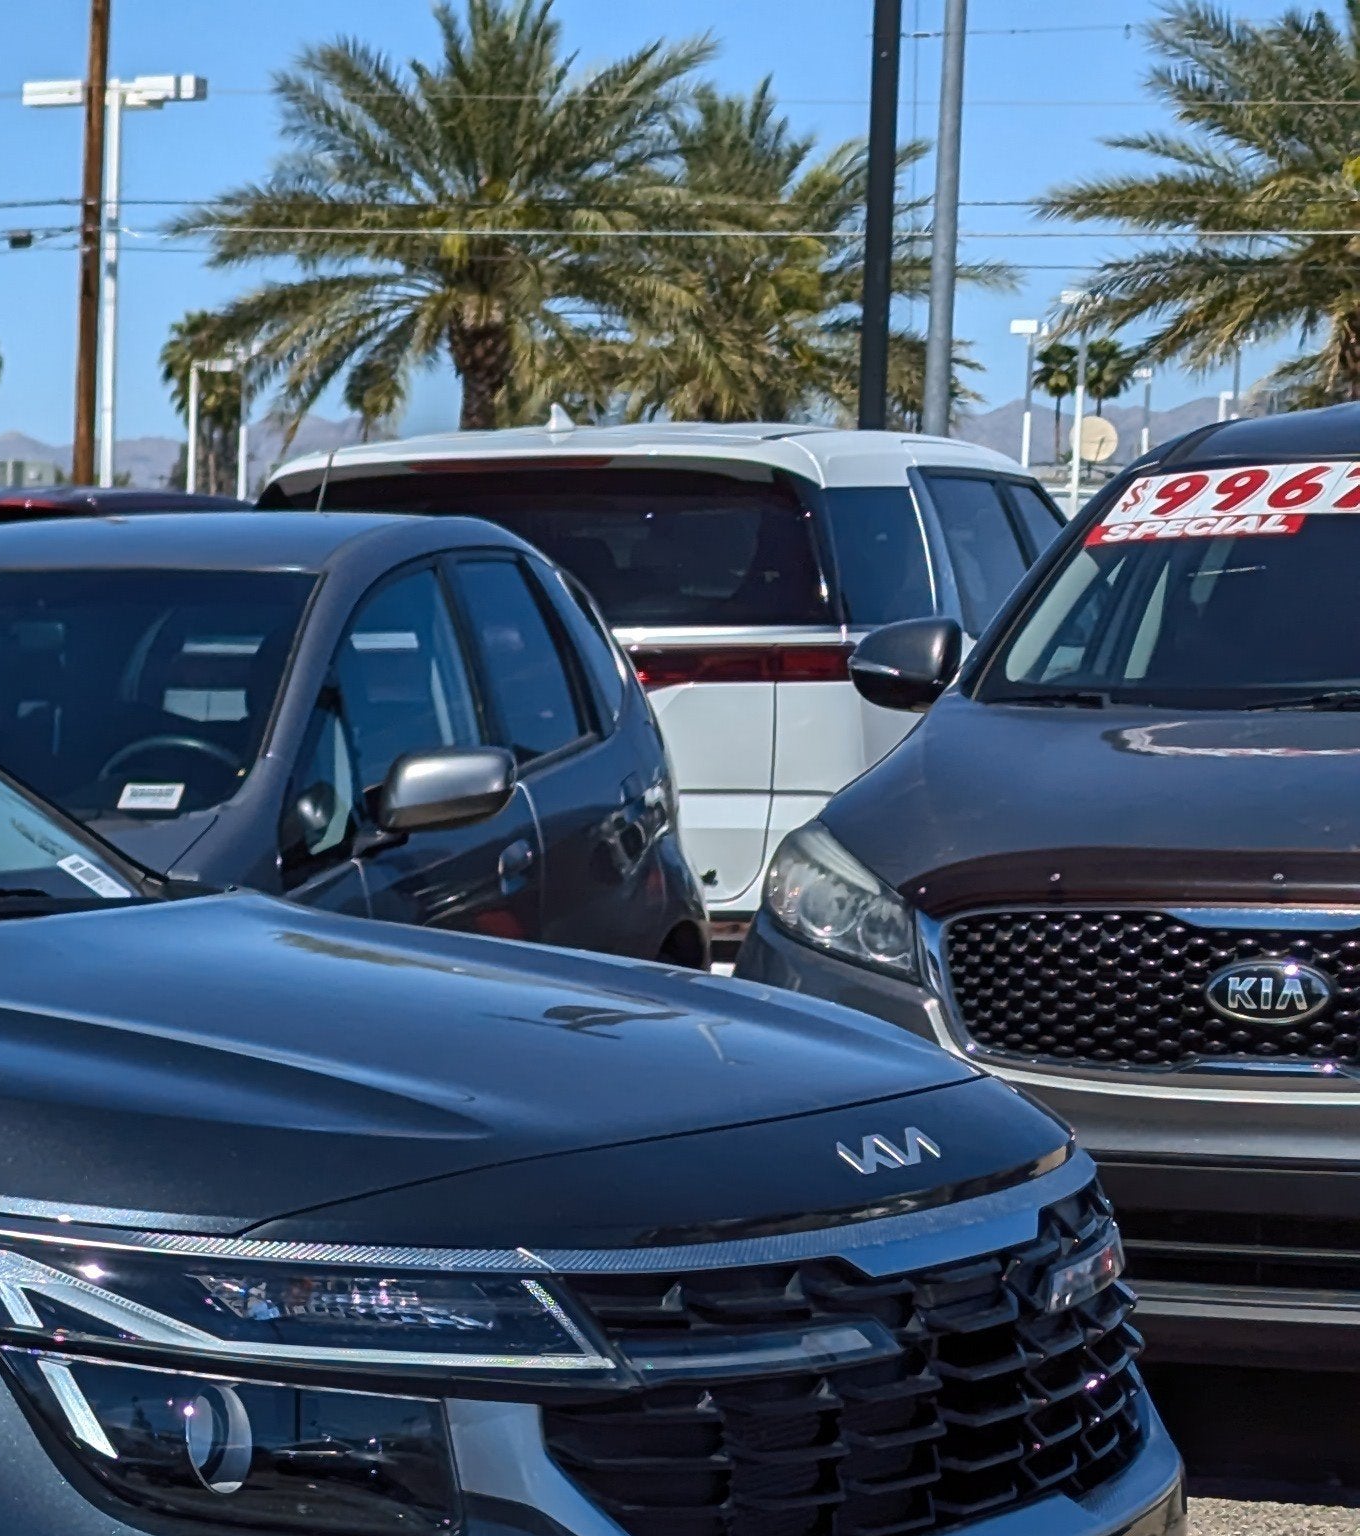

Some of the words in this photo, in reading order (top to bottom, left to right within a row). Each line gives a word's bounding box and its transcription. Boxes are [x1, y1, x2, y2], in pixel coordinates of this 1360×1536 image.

[1101, 514, 1289, 542] SPECIAL
[1228, 977, 1308, 1010] KIA
[836, 1126, 941, 1175] KIA
